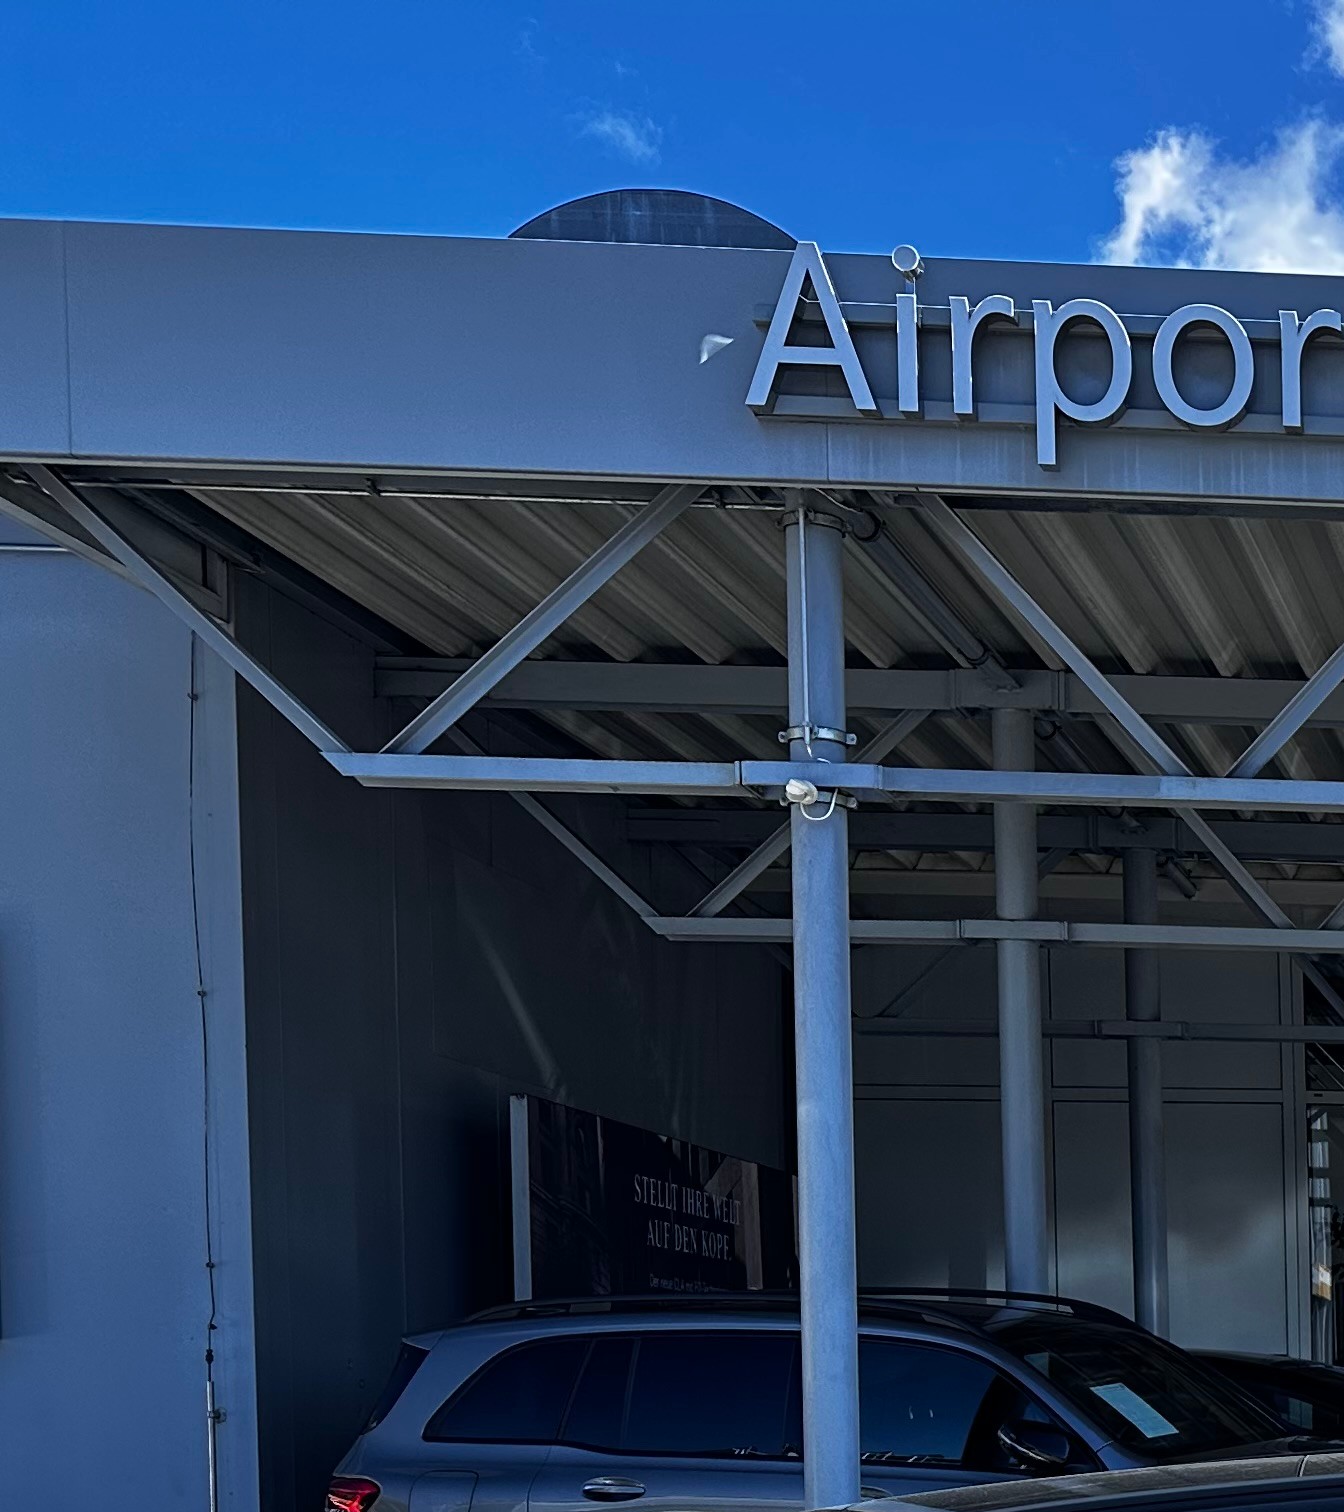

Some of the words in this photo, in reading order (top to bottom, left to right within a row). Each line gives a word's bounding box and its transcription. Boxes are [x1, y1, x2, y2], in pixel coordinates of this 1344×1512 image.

[633, 1173, 679, 1211] STELLT
[681, 1186, 710, 1219] IHRE
[711, 1194, 742, 1226] WELT
[647, 1218, 671, 1249] AUF
[674, 1223, 698, 1254] DEN
[701, 1230, 733, 1262] KOPF.
